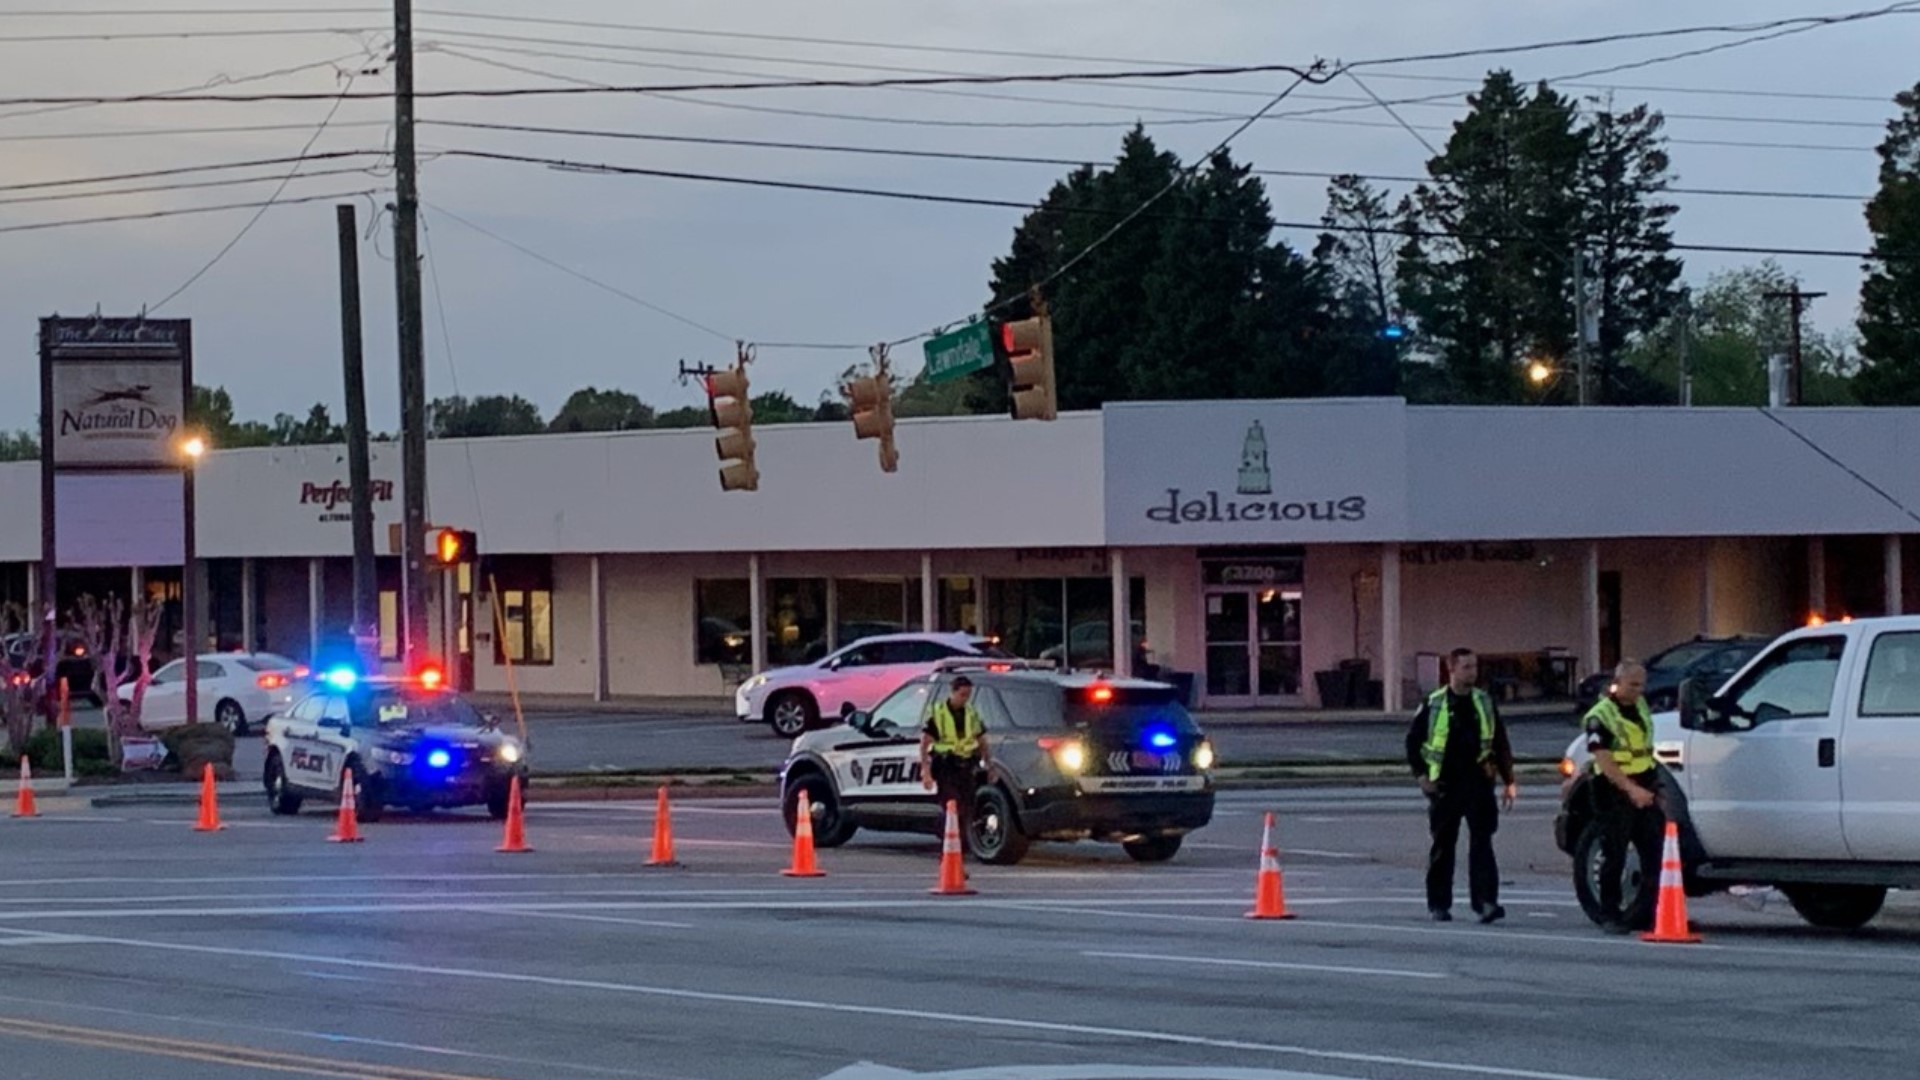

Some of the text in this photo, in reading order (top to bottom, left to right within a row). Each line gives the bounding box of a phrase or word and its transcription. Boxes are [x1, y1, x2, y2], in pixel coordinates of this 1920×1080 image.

[61, 407, 177, 436] Natural Dog
[300, 480, 352, 510] Perfec
[1146, 488, 1366, 524] delicious
